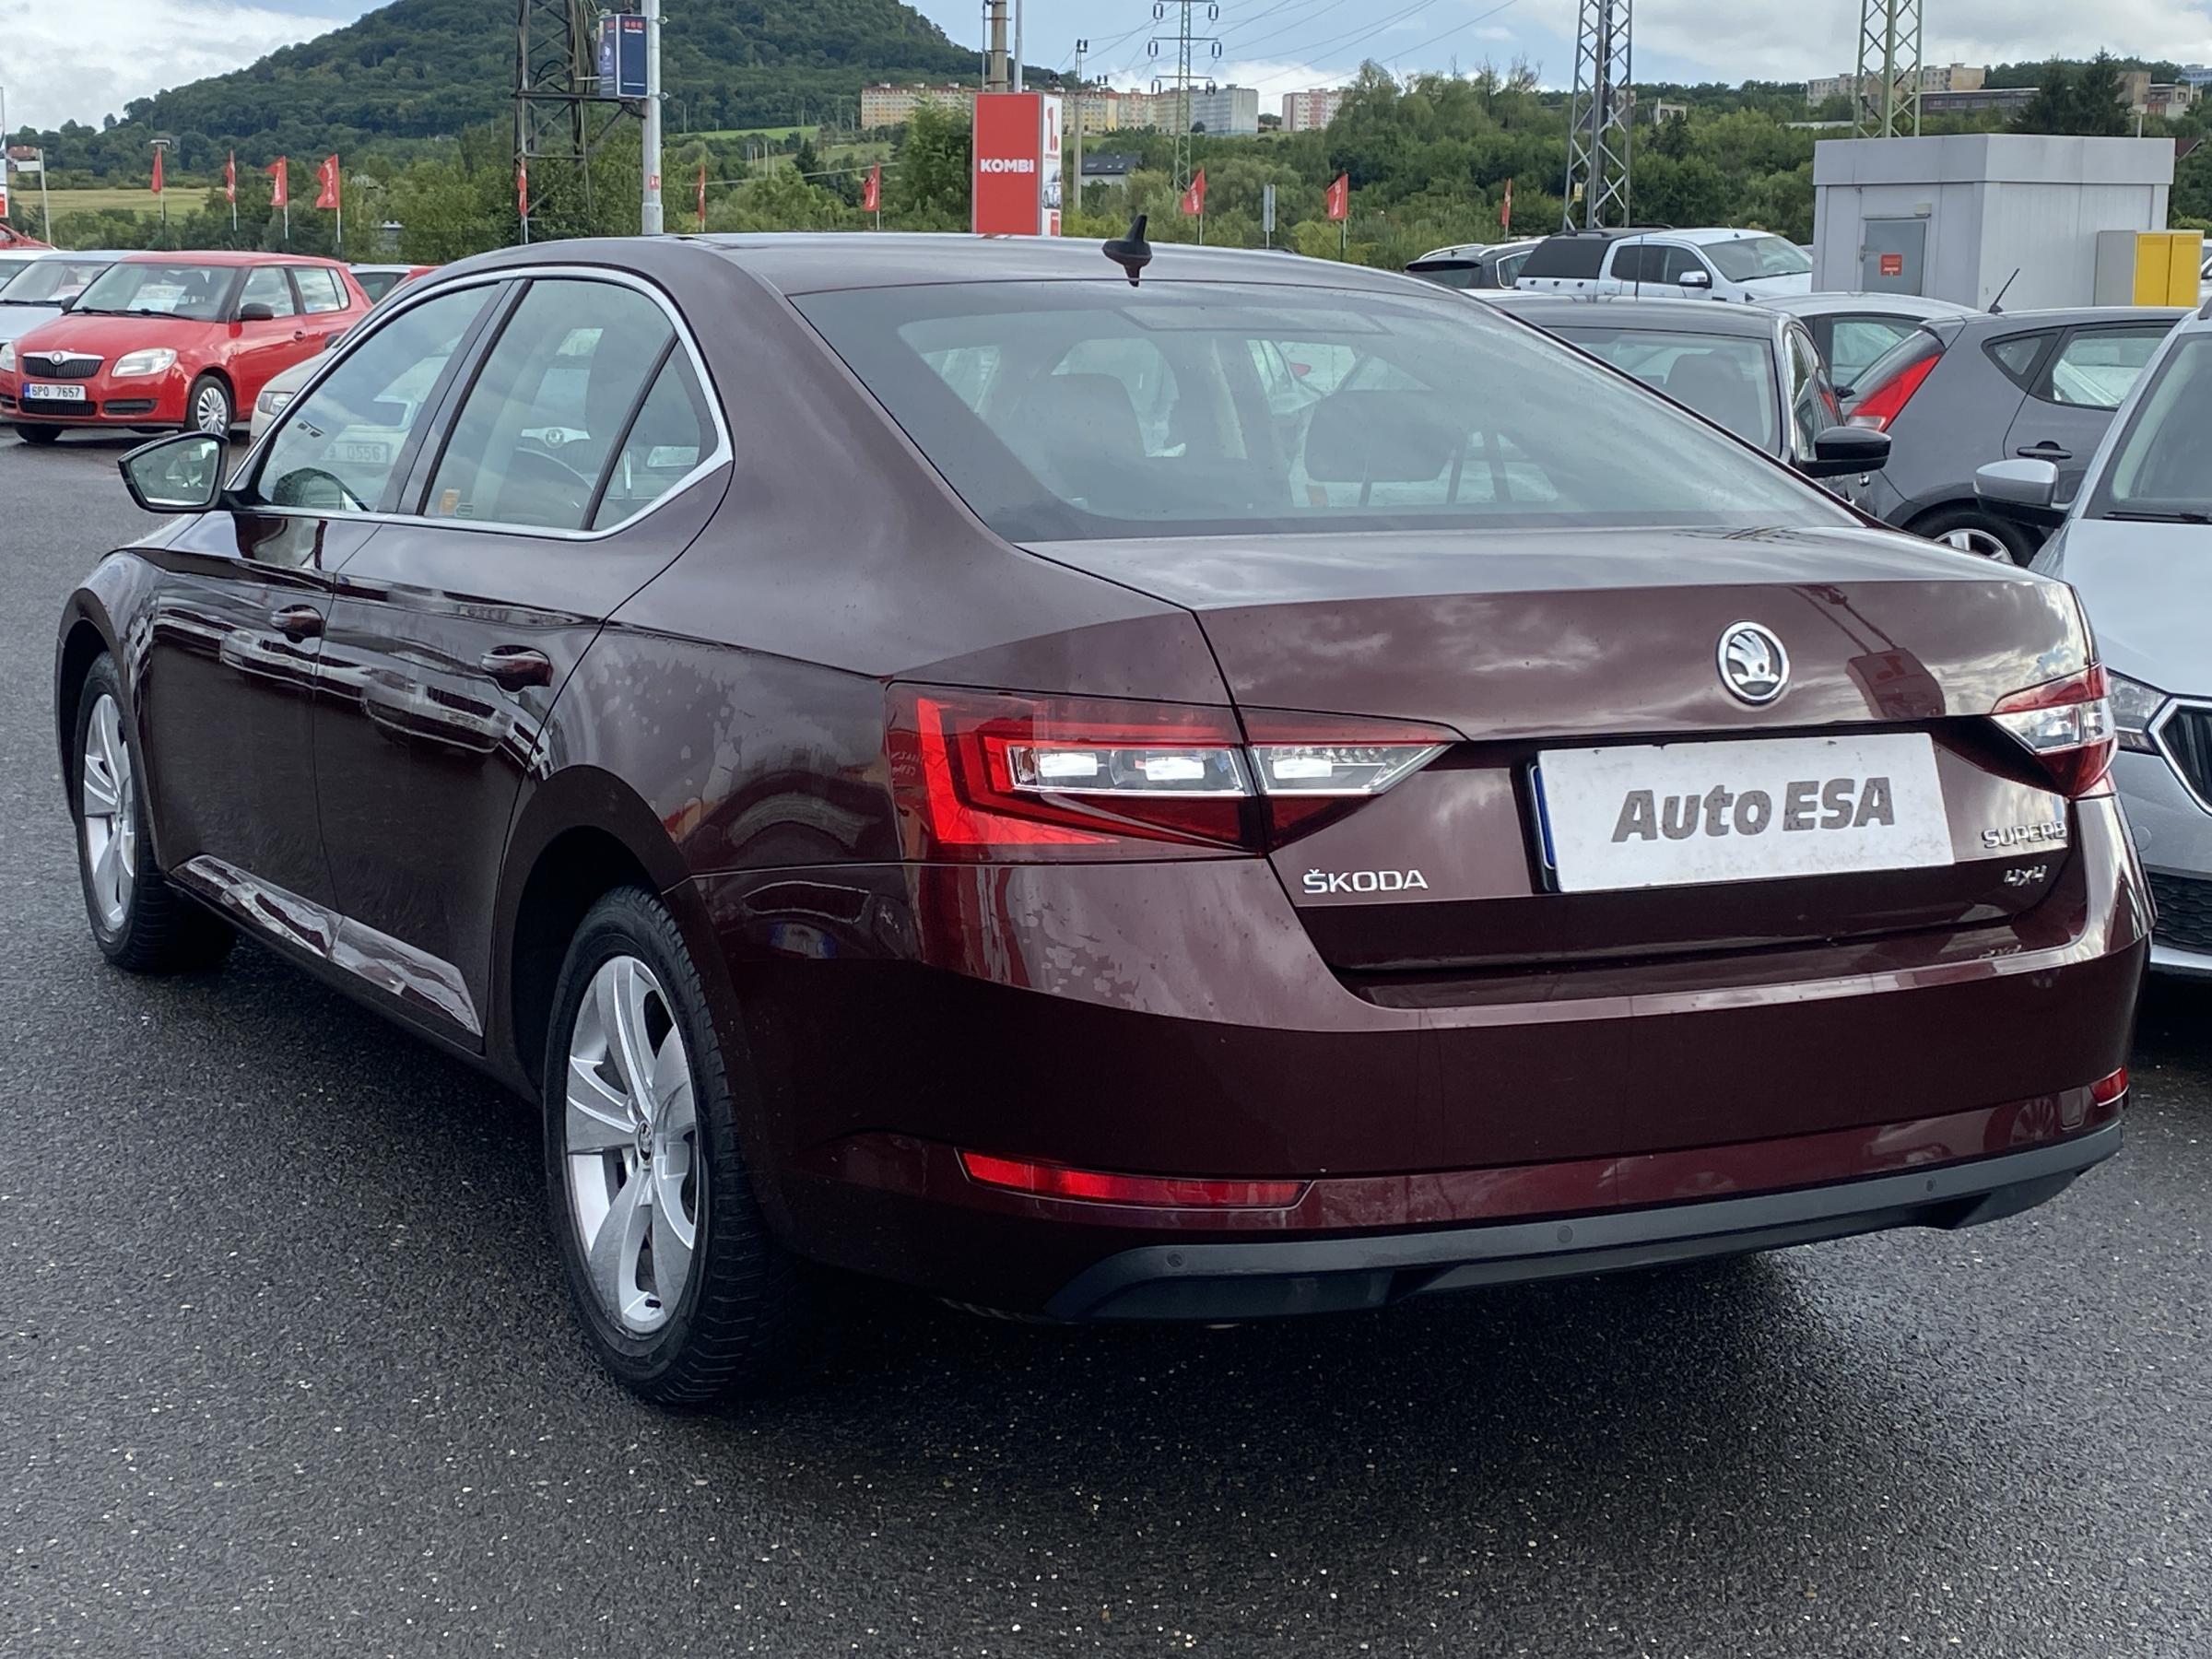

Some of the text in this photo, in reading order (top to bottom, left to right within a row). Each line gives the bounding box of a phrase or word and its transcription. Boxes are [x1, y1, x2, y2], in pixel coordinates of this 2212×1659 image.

[980, 159, 1035, 173] KOMBI
[55, 386, 80, 398] 7657
[1611, 776, 1895, 842] Auto ESA
[1982, 820, 2067, 848] SUPERB
[1302, 869, 1429, 894] ŠKODA
[2004, 865, 2047, 886] 4x4
